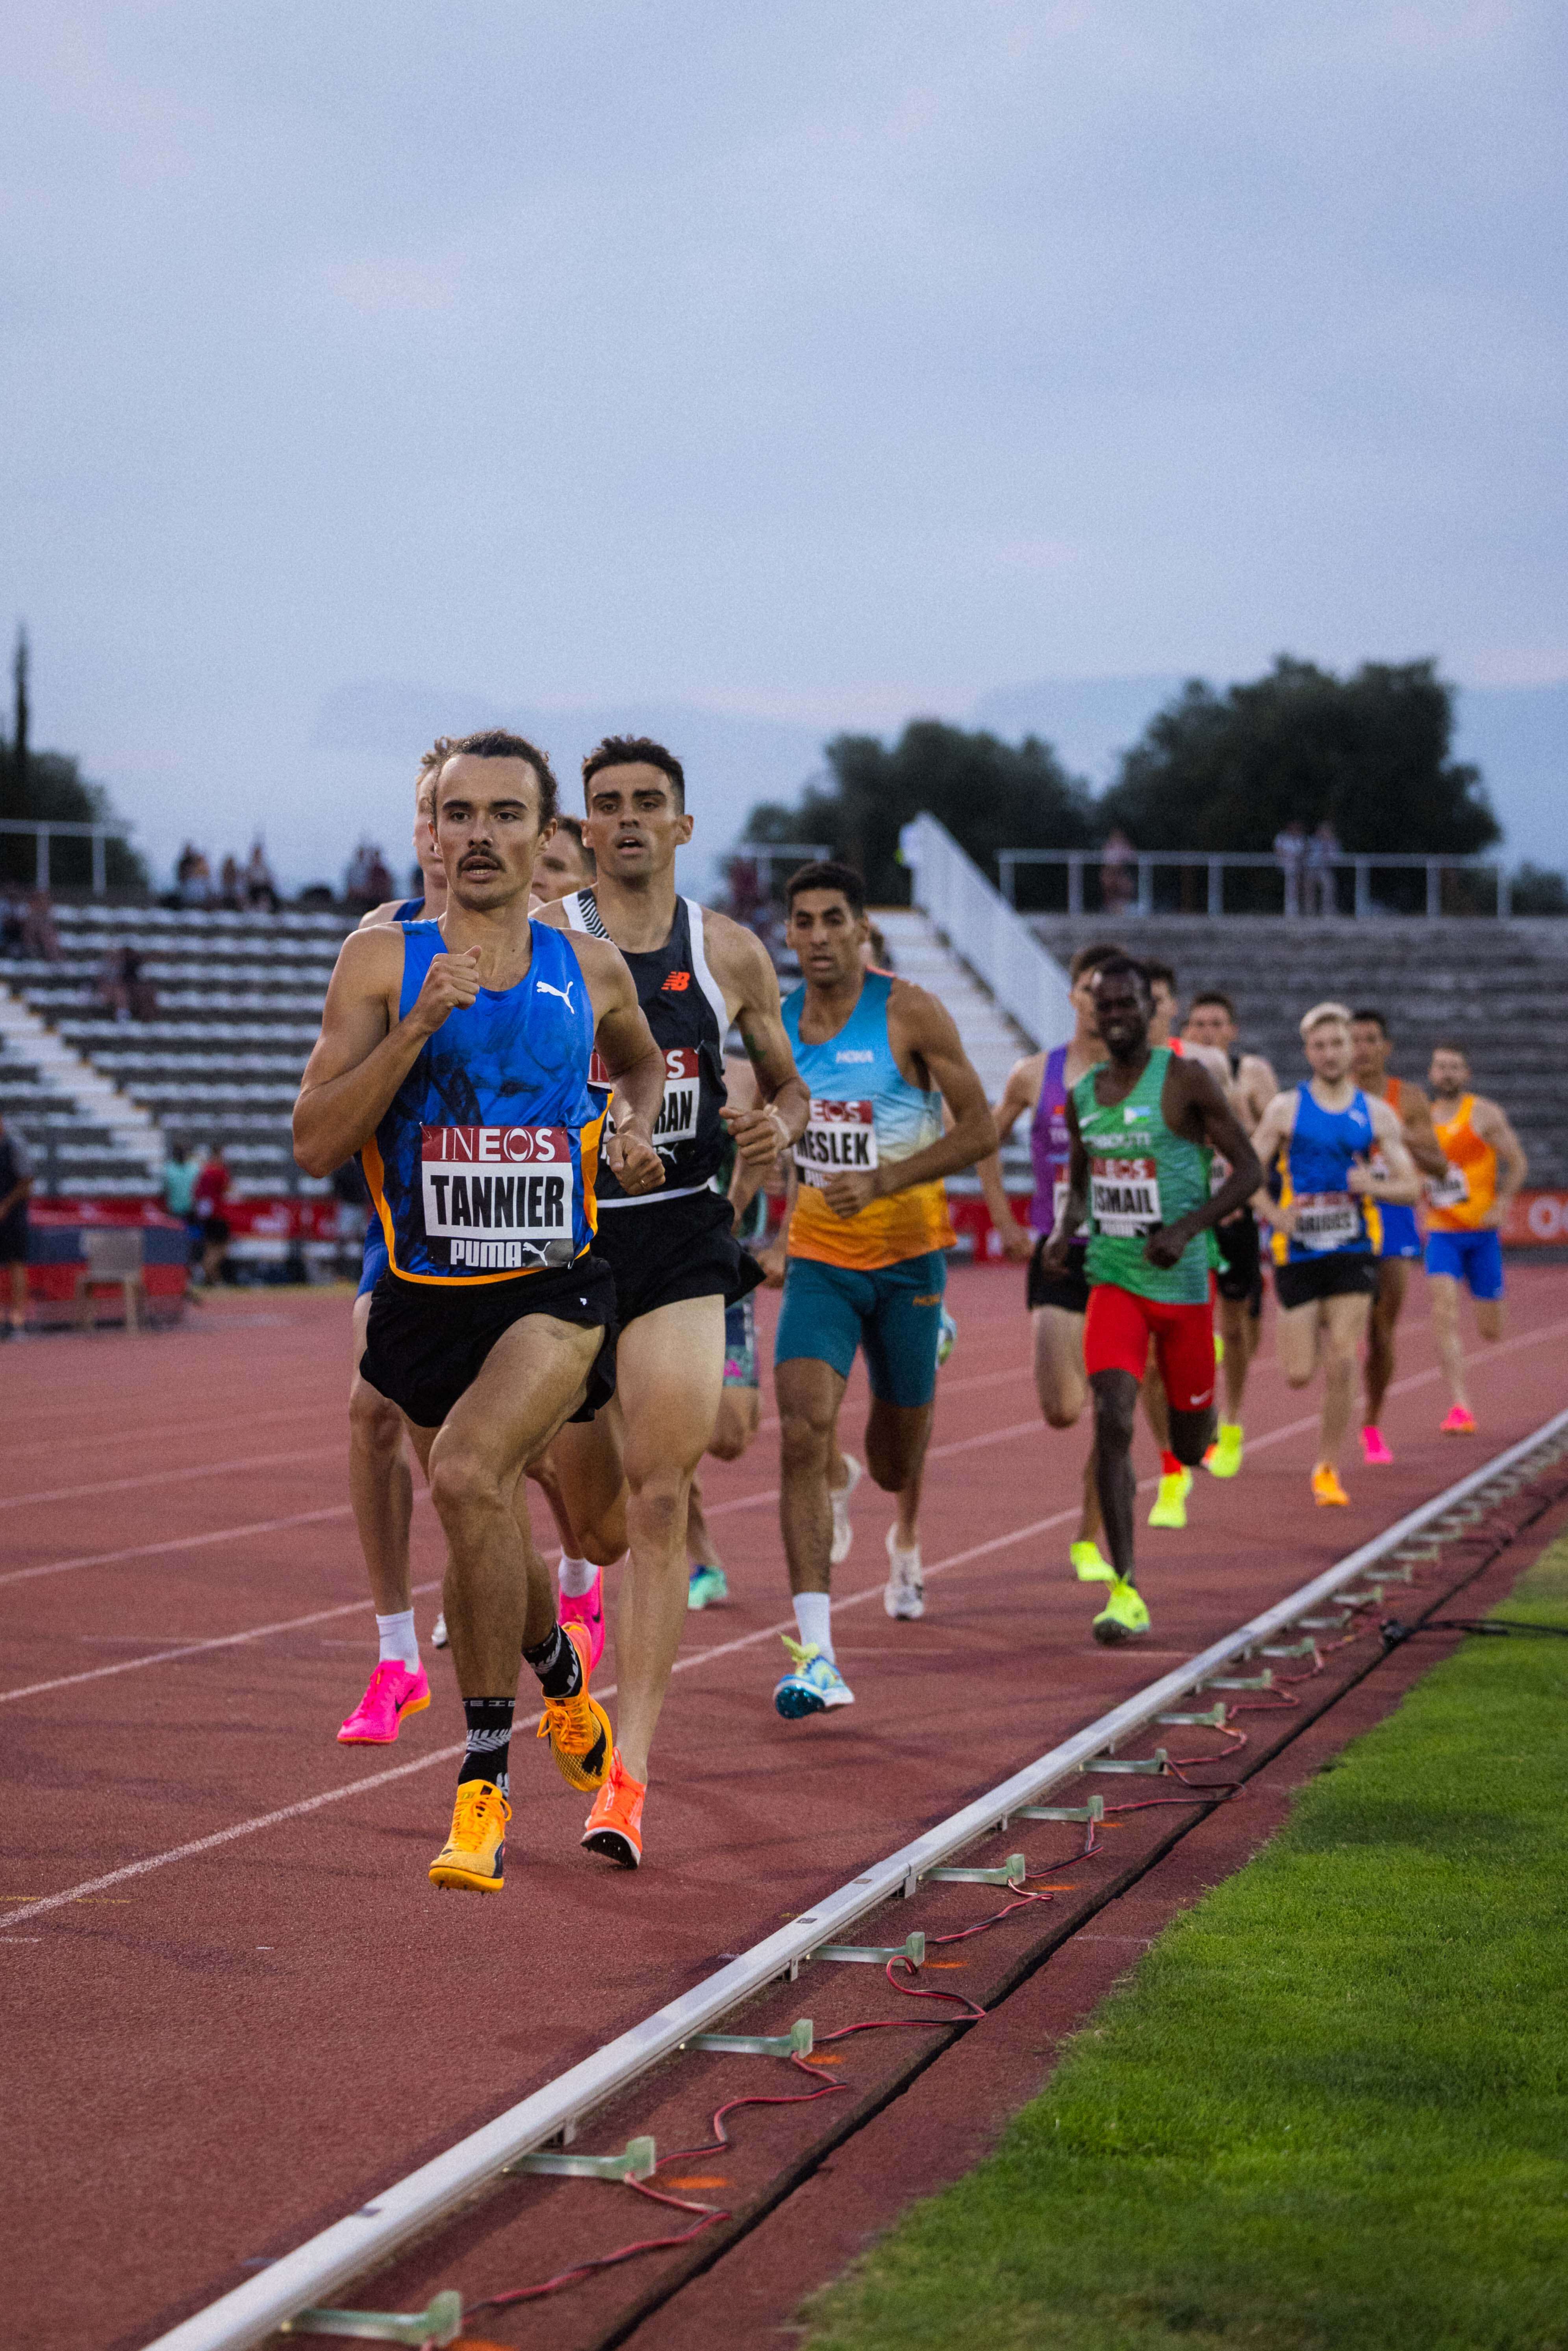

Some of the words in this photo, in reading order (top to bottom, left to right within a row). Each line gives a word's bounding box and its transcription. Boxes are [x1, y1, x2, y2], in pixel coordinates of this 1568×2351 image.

[440, 1127, 556, 1162] INEOS
[430, 1175, 565, 1228] TANNIER
[450, 1239, 522, 1268] PUMA
